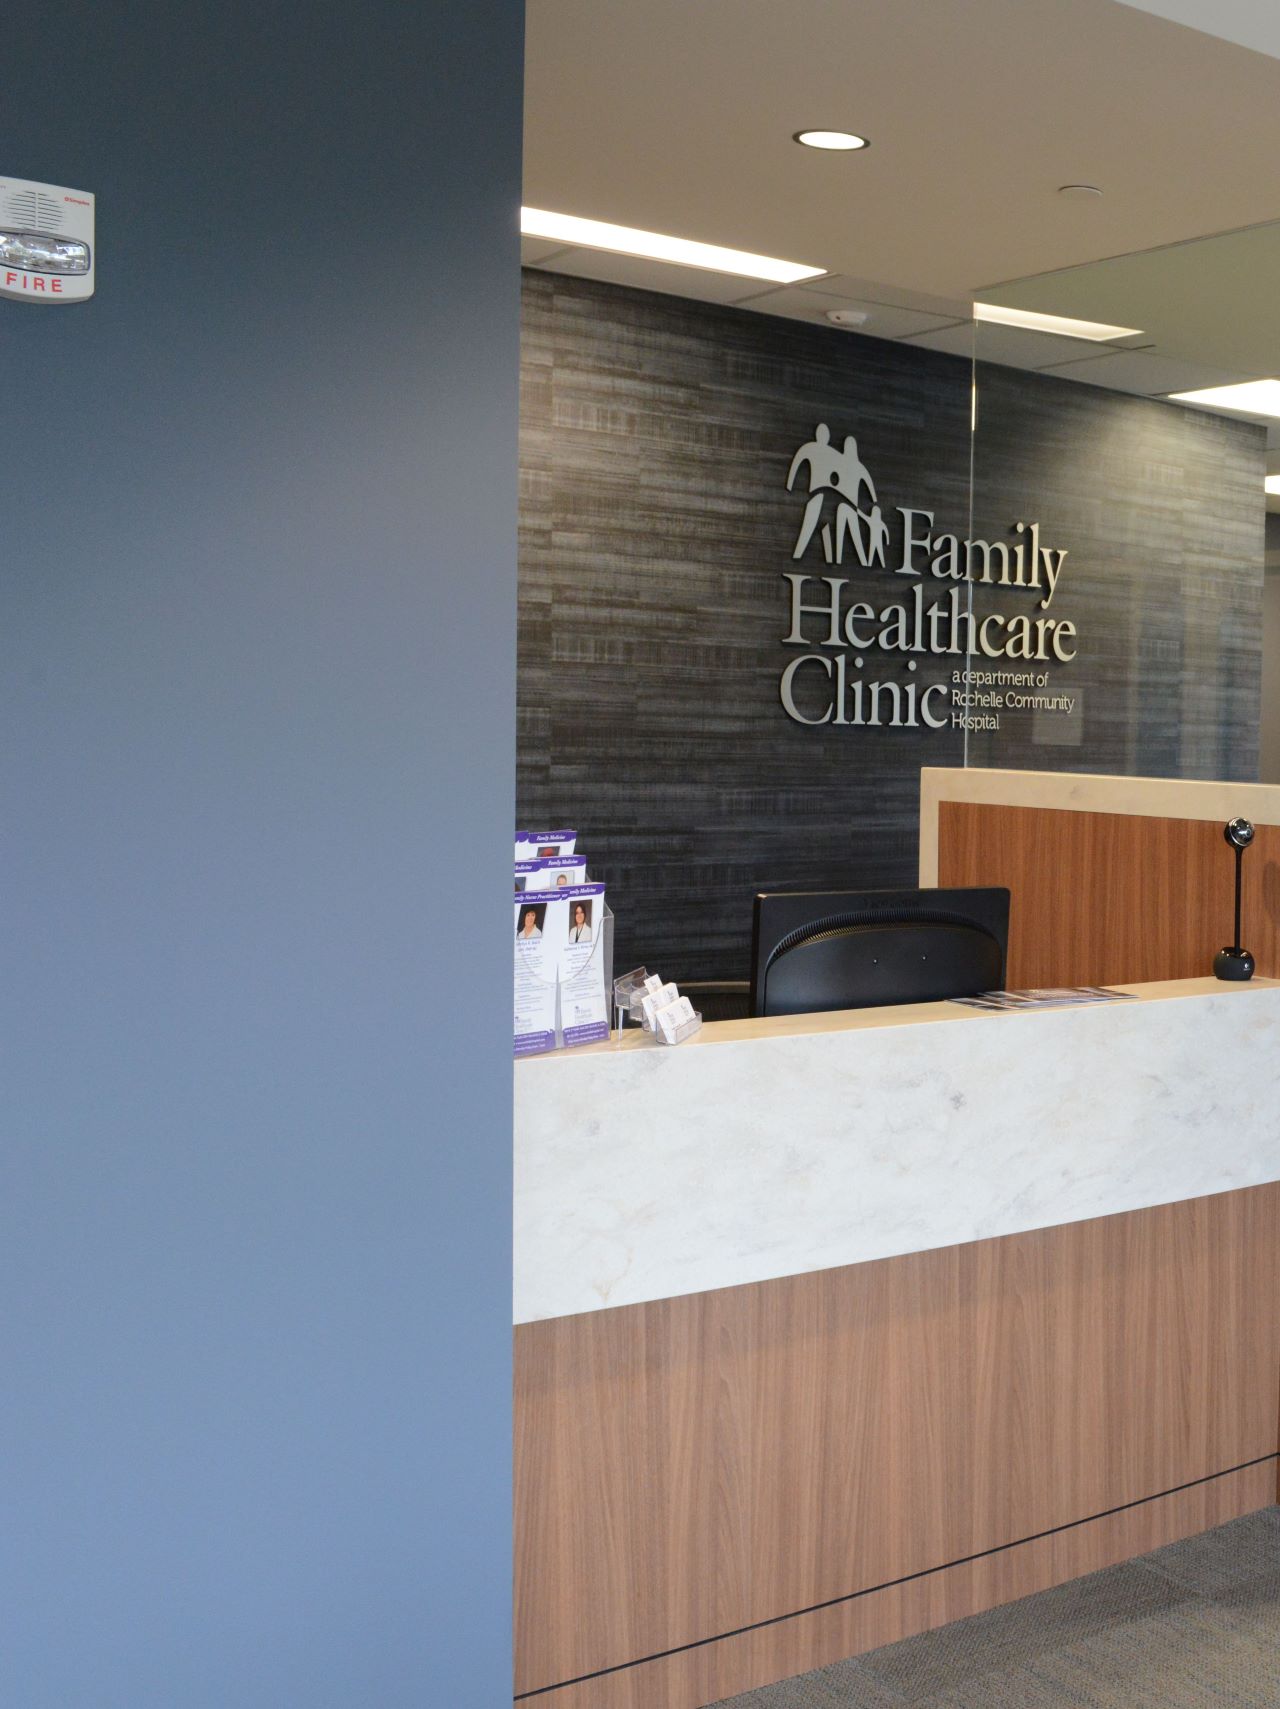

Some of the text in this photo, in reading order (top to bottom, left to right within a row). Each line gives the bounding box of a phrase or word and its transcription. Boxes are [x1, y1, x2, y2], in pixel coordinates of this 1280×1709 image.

[6, 272, 63, 293] FIRE
[894, 506, 1069, 610] Family
[781, 573, 1078, 662] Healthcare
[780, 654, 948, 728] Clinic
[952, 670, 960, 683] a
[1036, 671, 1050, 688] of
[952, 689, 1075, 714] Rochelle Community
[951, 712, 1000, 732] Hospital
